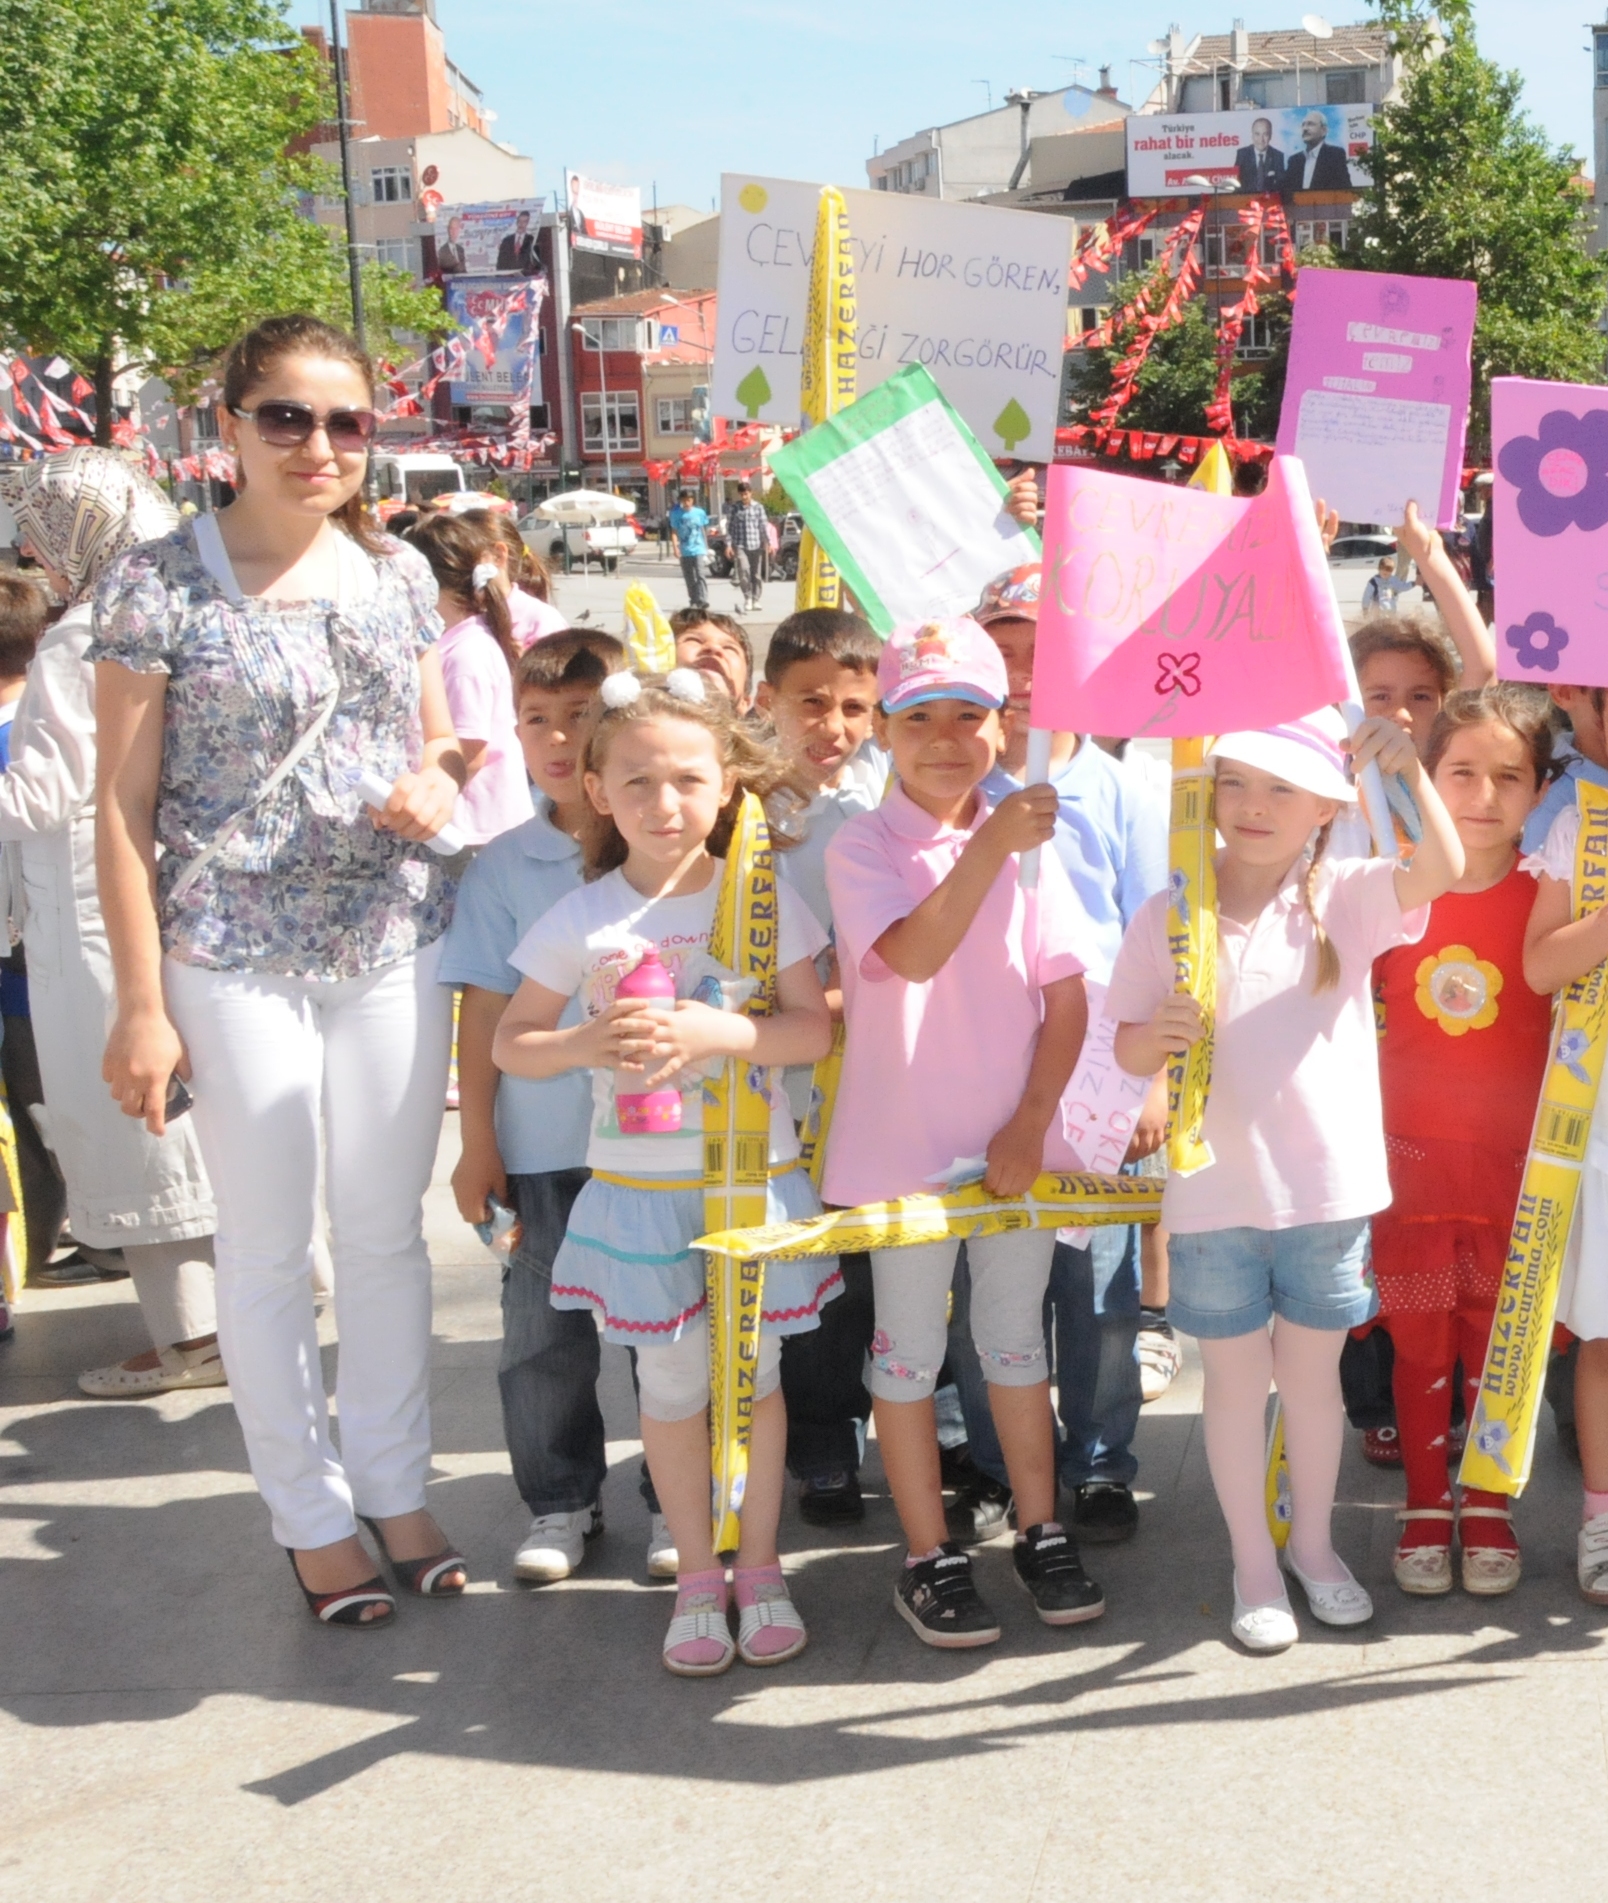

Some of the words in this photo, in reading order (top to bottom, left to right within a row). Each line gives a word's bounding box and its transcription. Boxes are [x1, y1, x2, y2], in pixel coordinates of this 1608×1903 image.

[1134, 135, 1171, 150] rahat
[1175, 134, 1194, 149] bir
[1200, 132, 1239, 148] nefes
[897, 246, 956, 279] HOR
[964, 256, 1061, 295] GÖREN,
